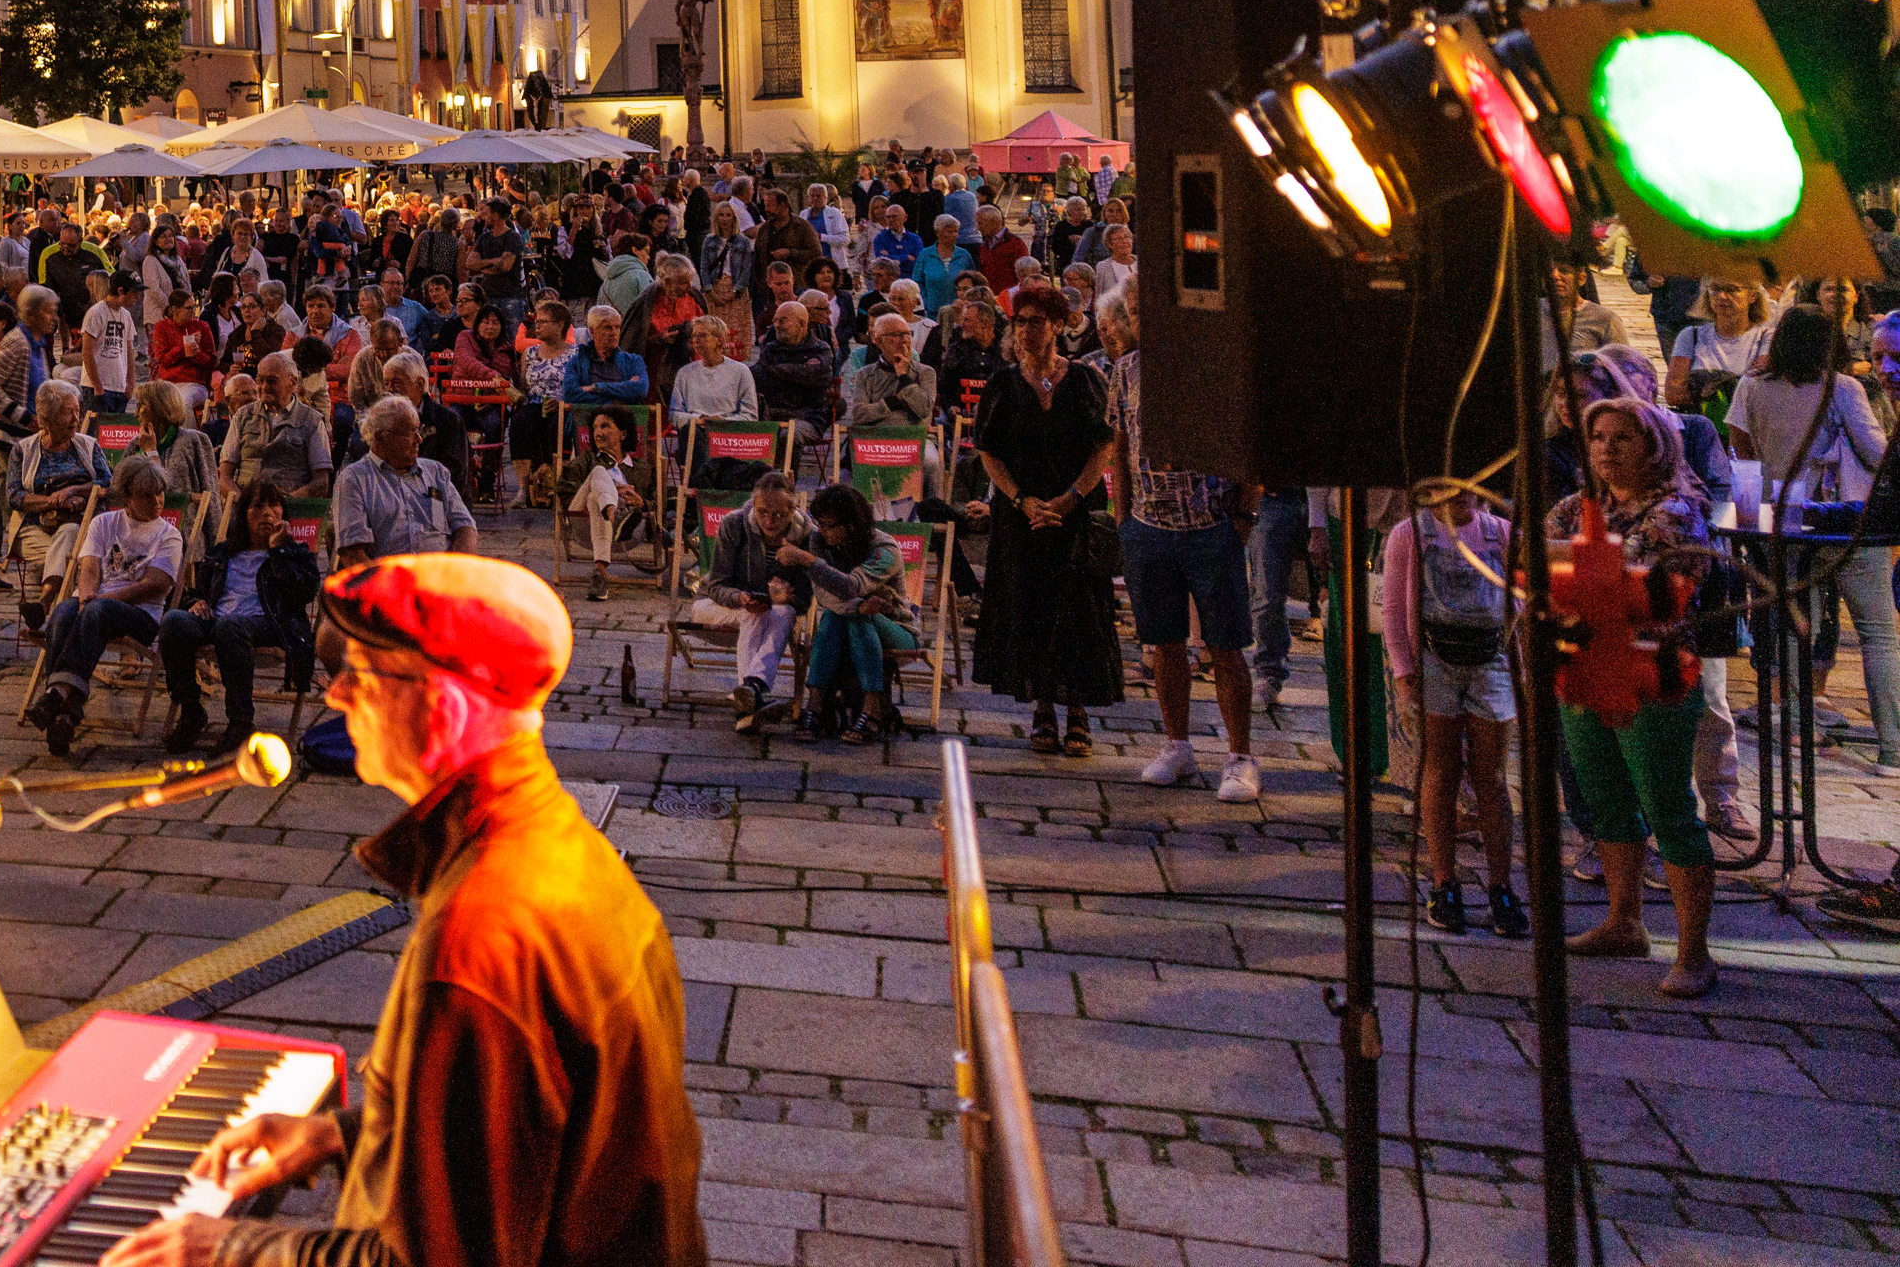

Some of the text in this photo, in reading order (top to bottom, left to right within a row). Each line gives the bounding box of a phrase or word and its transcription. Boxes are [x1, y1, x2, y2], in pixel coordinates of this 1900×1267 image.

[364, 143, 406, 156] CAFÉ
[3, 157, 83, 170] EIS CAFÉ
[451, 380, 501, 388] KULTSOMMER
[712, 437, 770, 447] KULTSOMMER
[857, 444, 918, 454] KULTSOMMER
